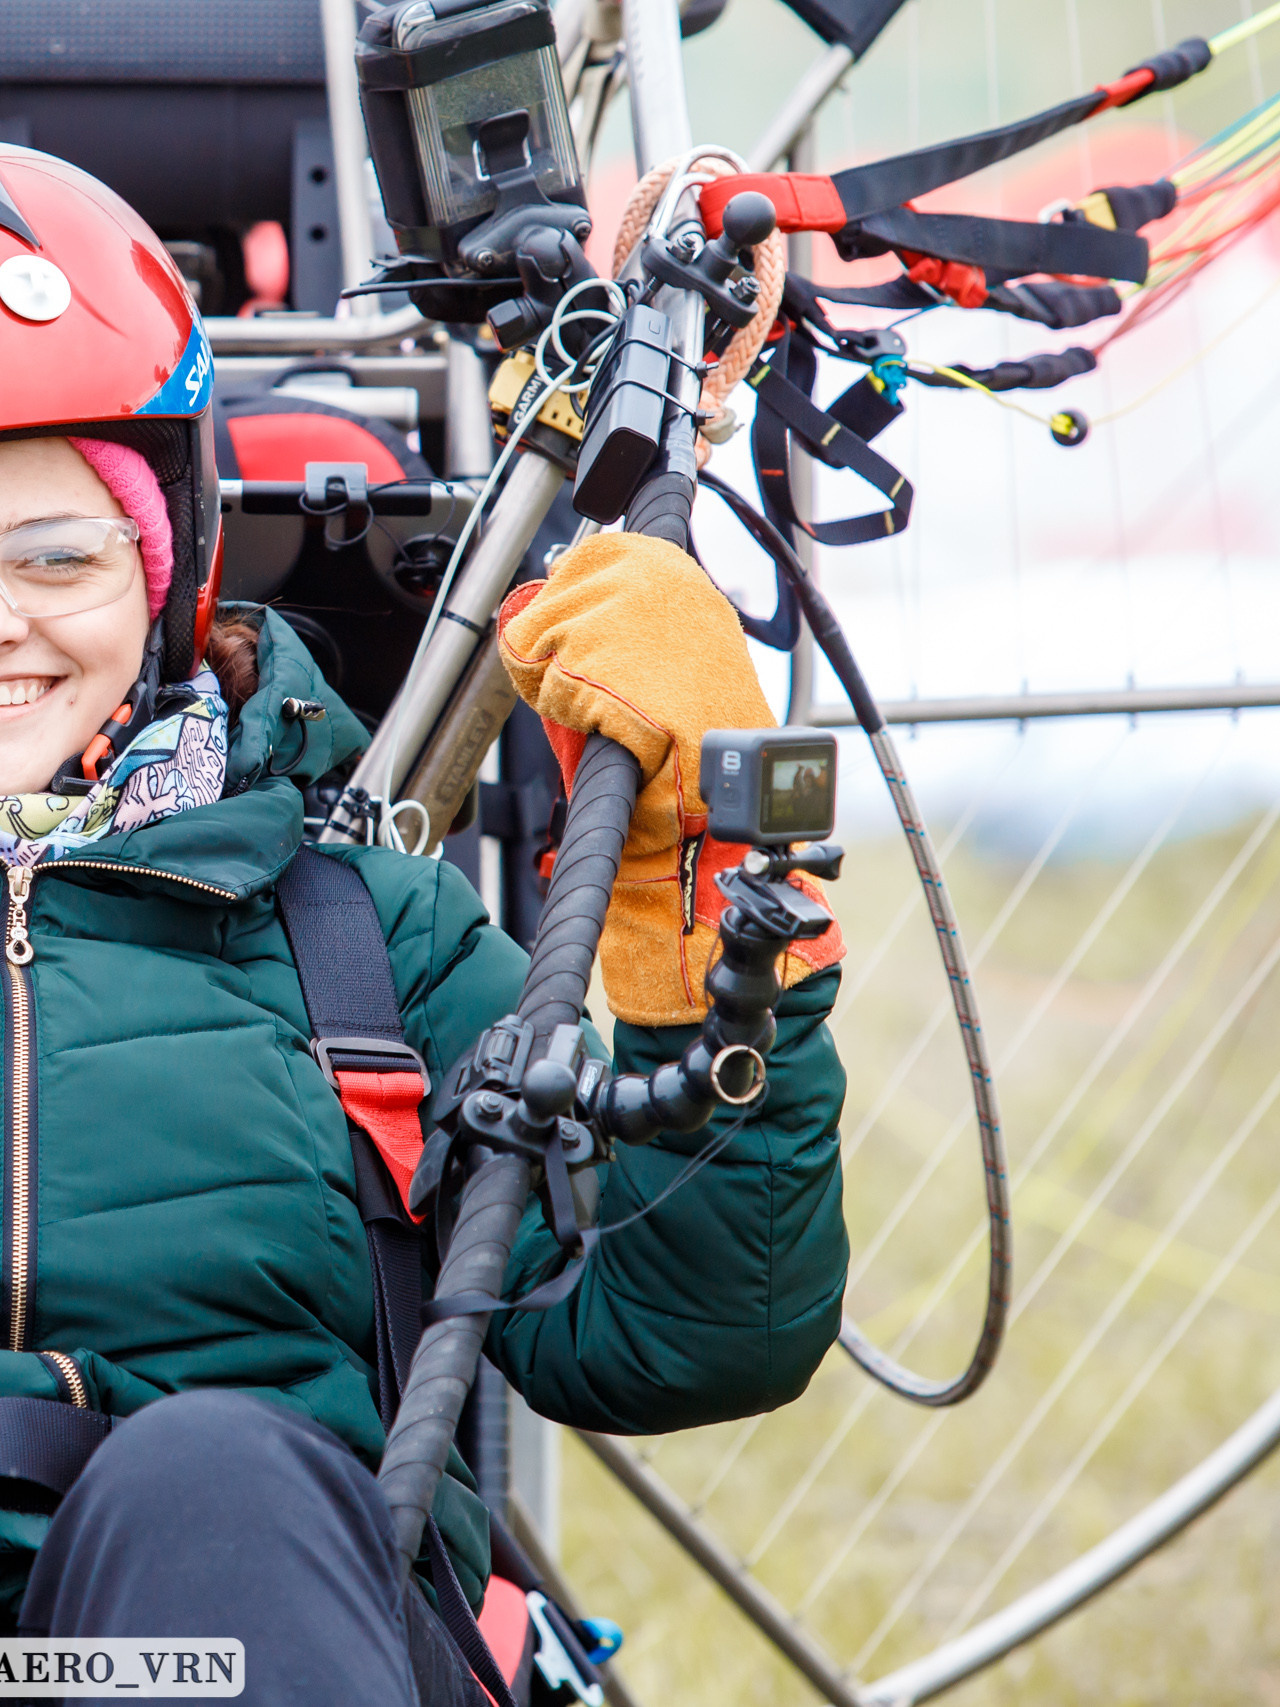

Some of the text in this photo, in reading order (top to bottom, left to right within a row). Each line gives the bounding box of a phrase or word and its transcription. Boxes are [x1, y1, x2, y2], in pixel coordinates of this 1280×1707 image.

[185, 339, 212, 408] SAL
[513, 364, 553, 425] GARMI
[722, 750, 741, 770] 8
